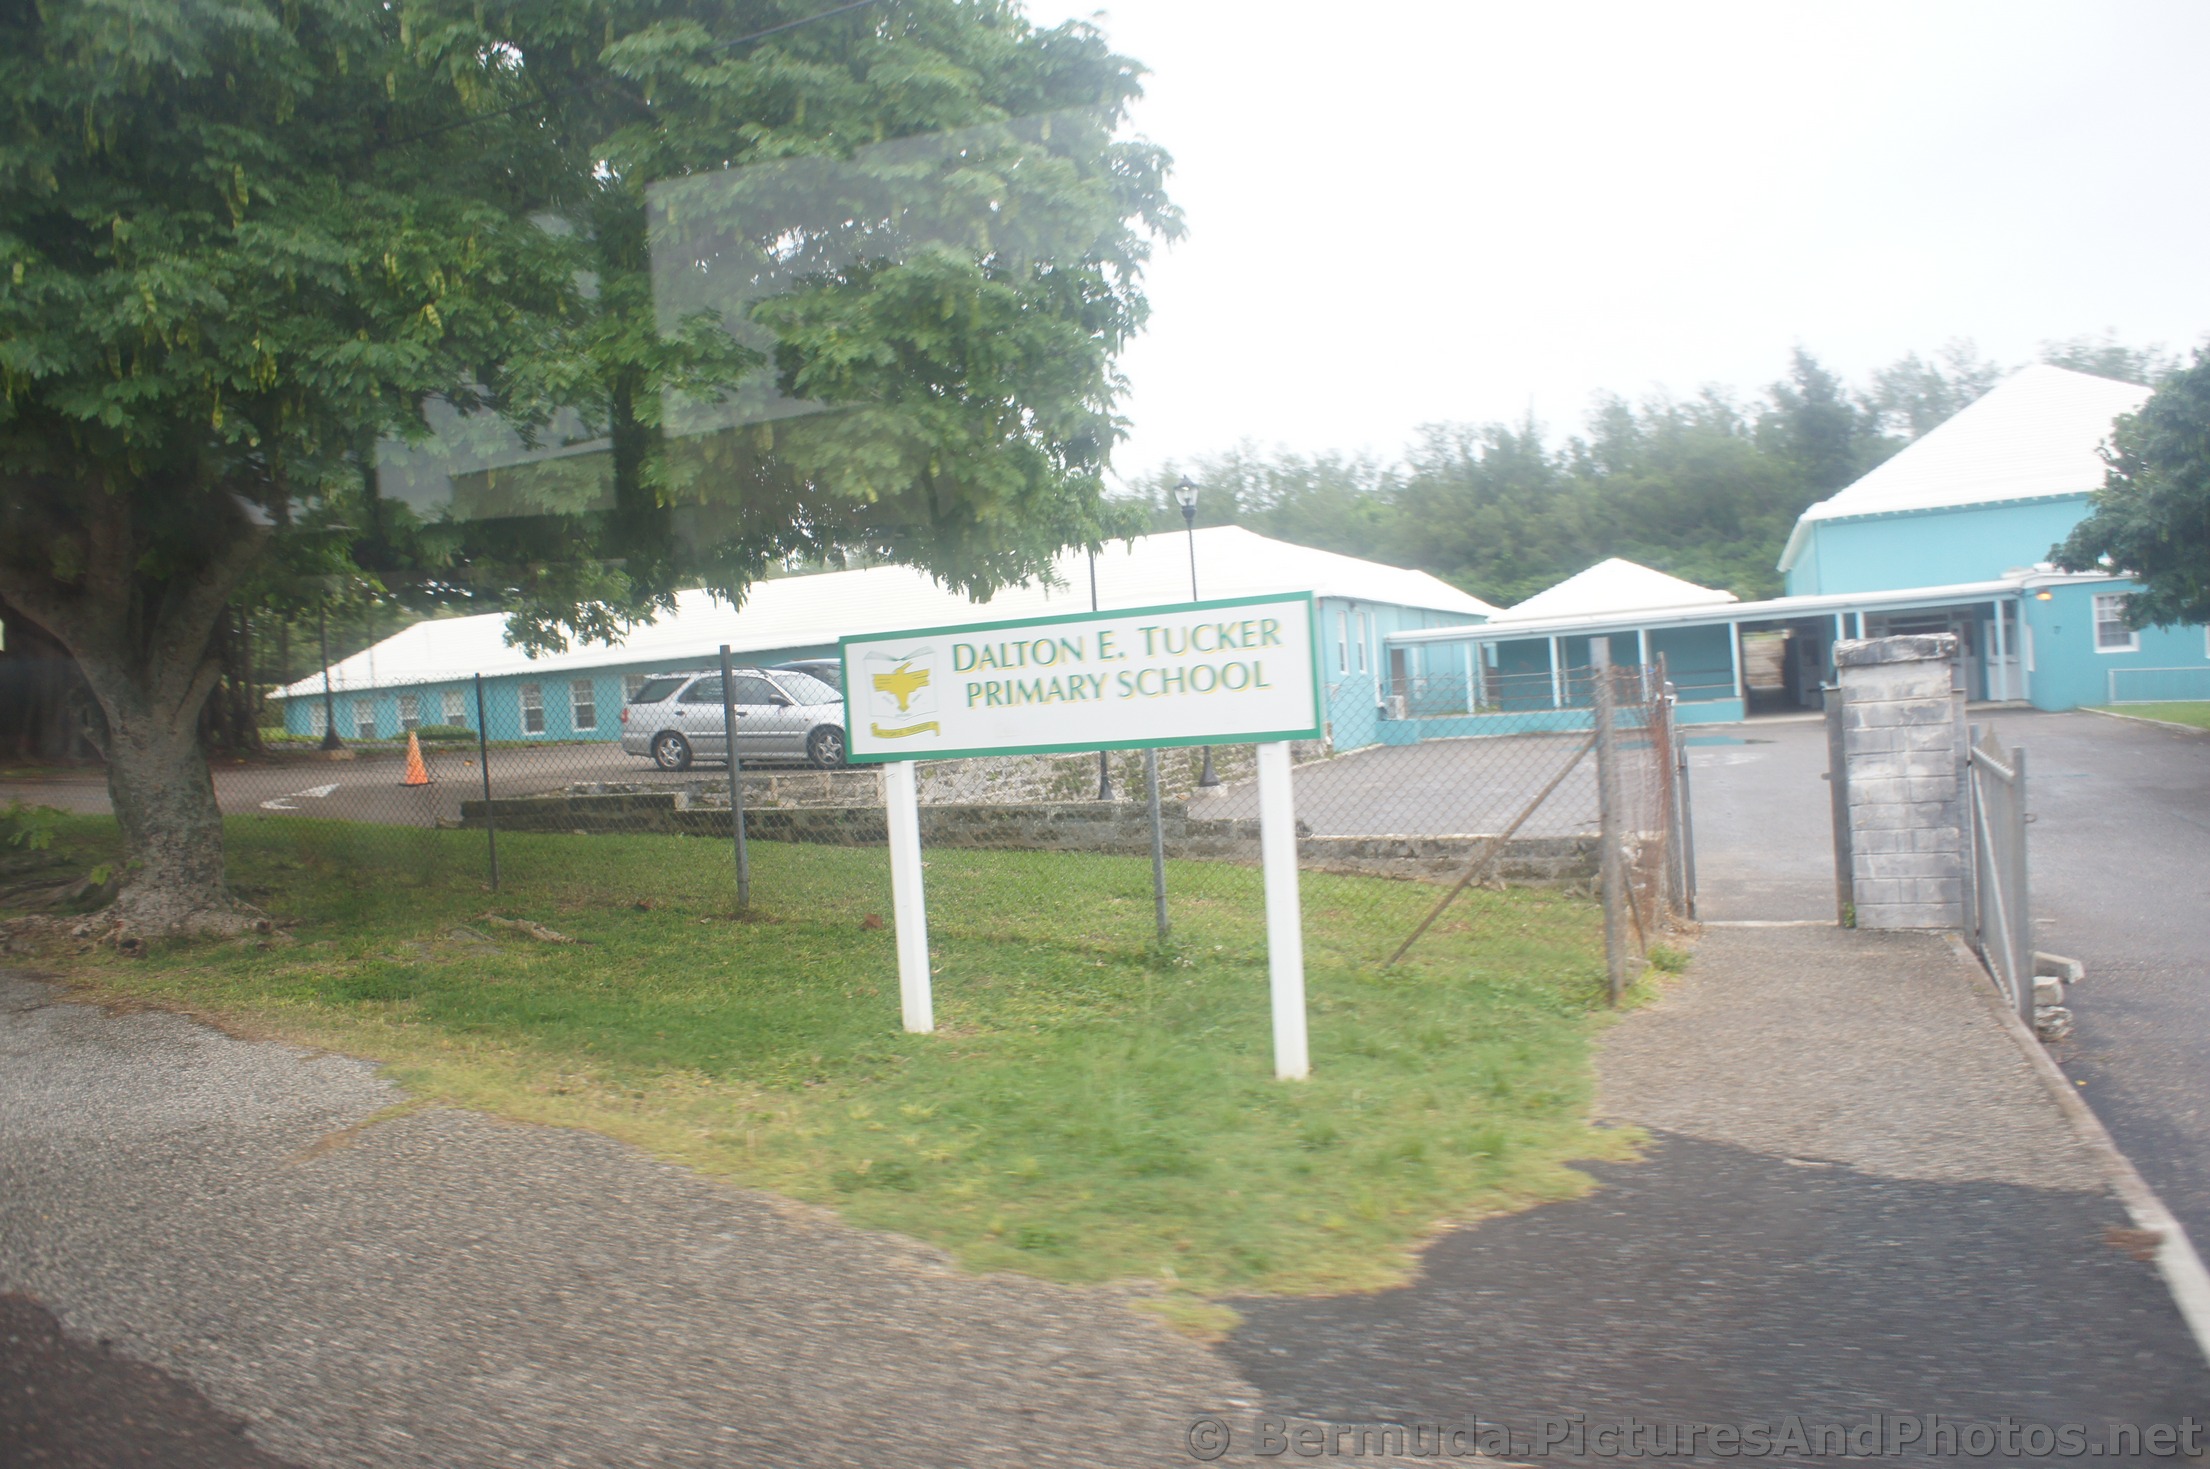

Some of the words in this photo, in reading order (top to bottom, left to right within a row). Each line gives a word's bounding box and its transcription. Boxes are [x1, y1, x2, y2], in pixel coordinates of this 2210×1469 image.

[952, 635, 1084, 673] DALTON
[1098, 631, 1126, 662] E.
[1138, 618, 1281, 656] TUCKER
[966, 673, 1106, 708] PRIMARY
[1117, 661, 1271, 698] SCHOOL
